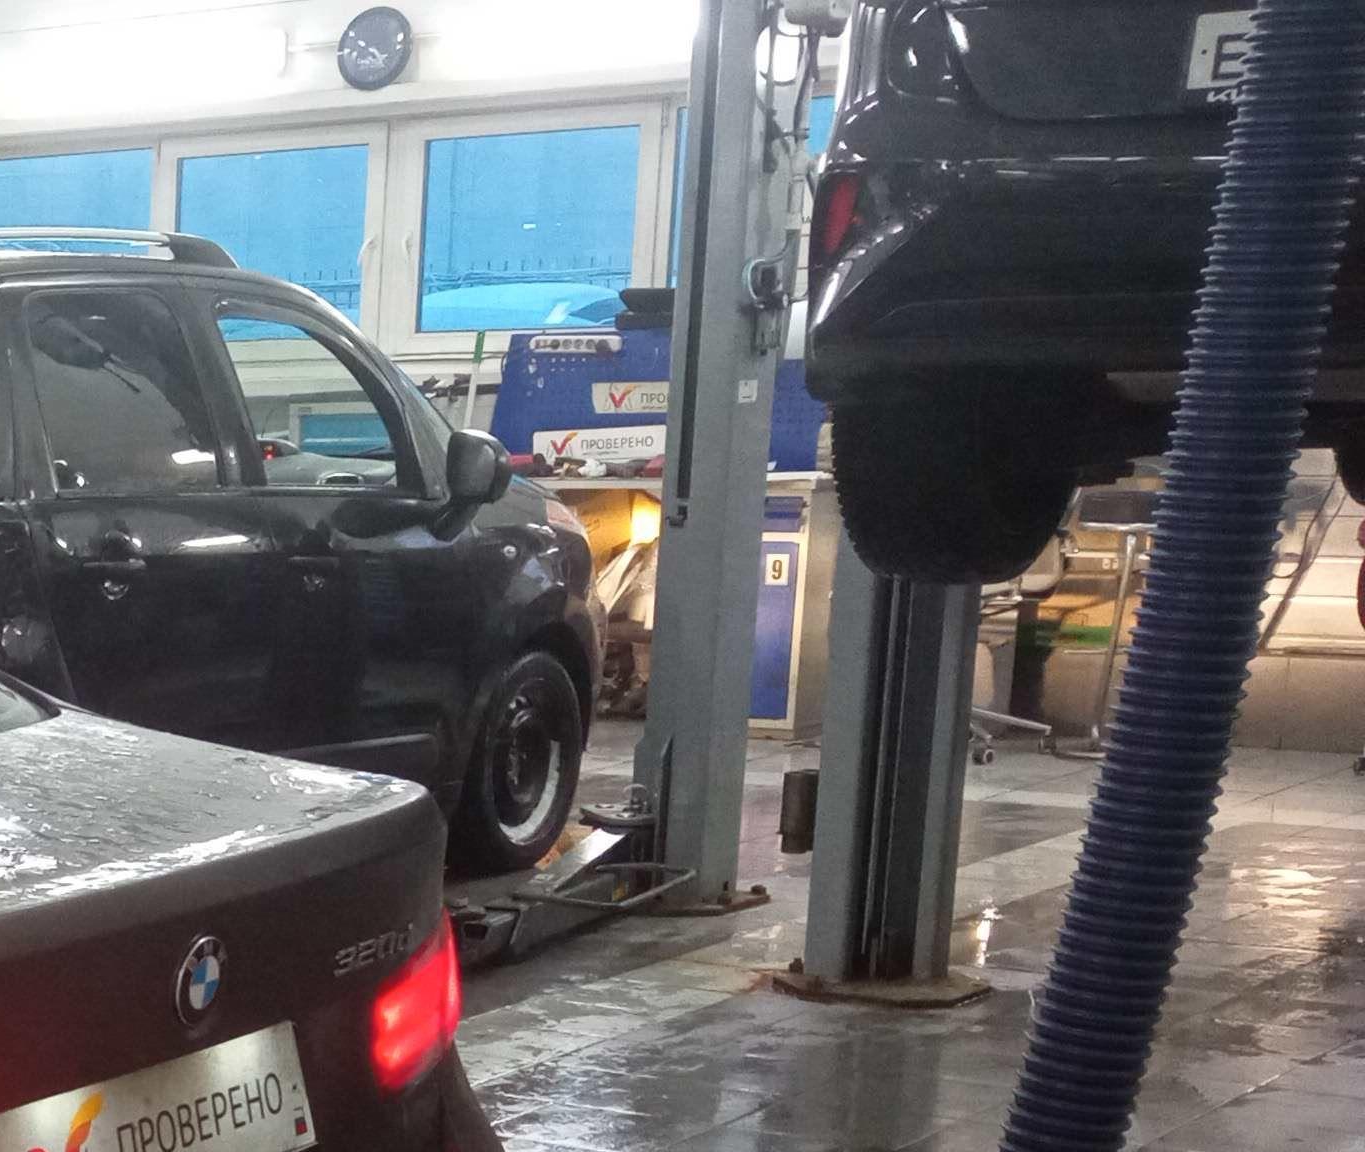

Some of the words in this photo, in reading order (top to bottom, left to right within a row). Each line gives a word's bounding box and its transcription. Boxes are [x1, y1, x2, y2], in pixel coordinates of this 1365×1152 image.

[641, 392, 669, 404] ПРО
[581, 435, 654, 450] ПРОВЕРЕНО
[771, 559, 783, 580] 9
